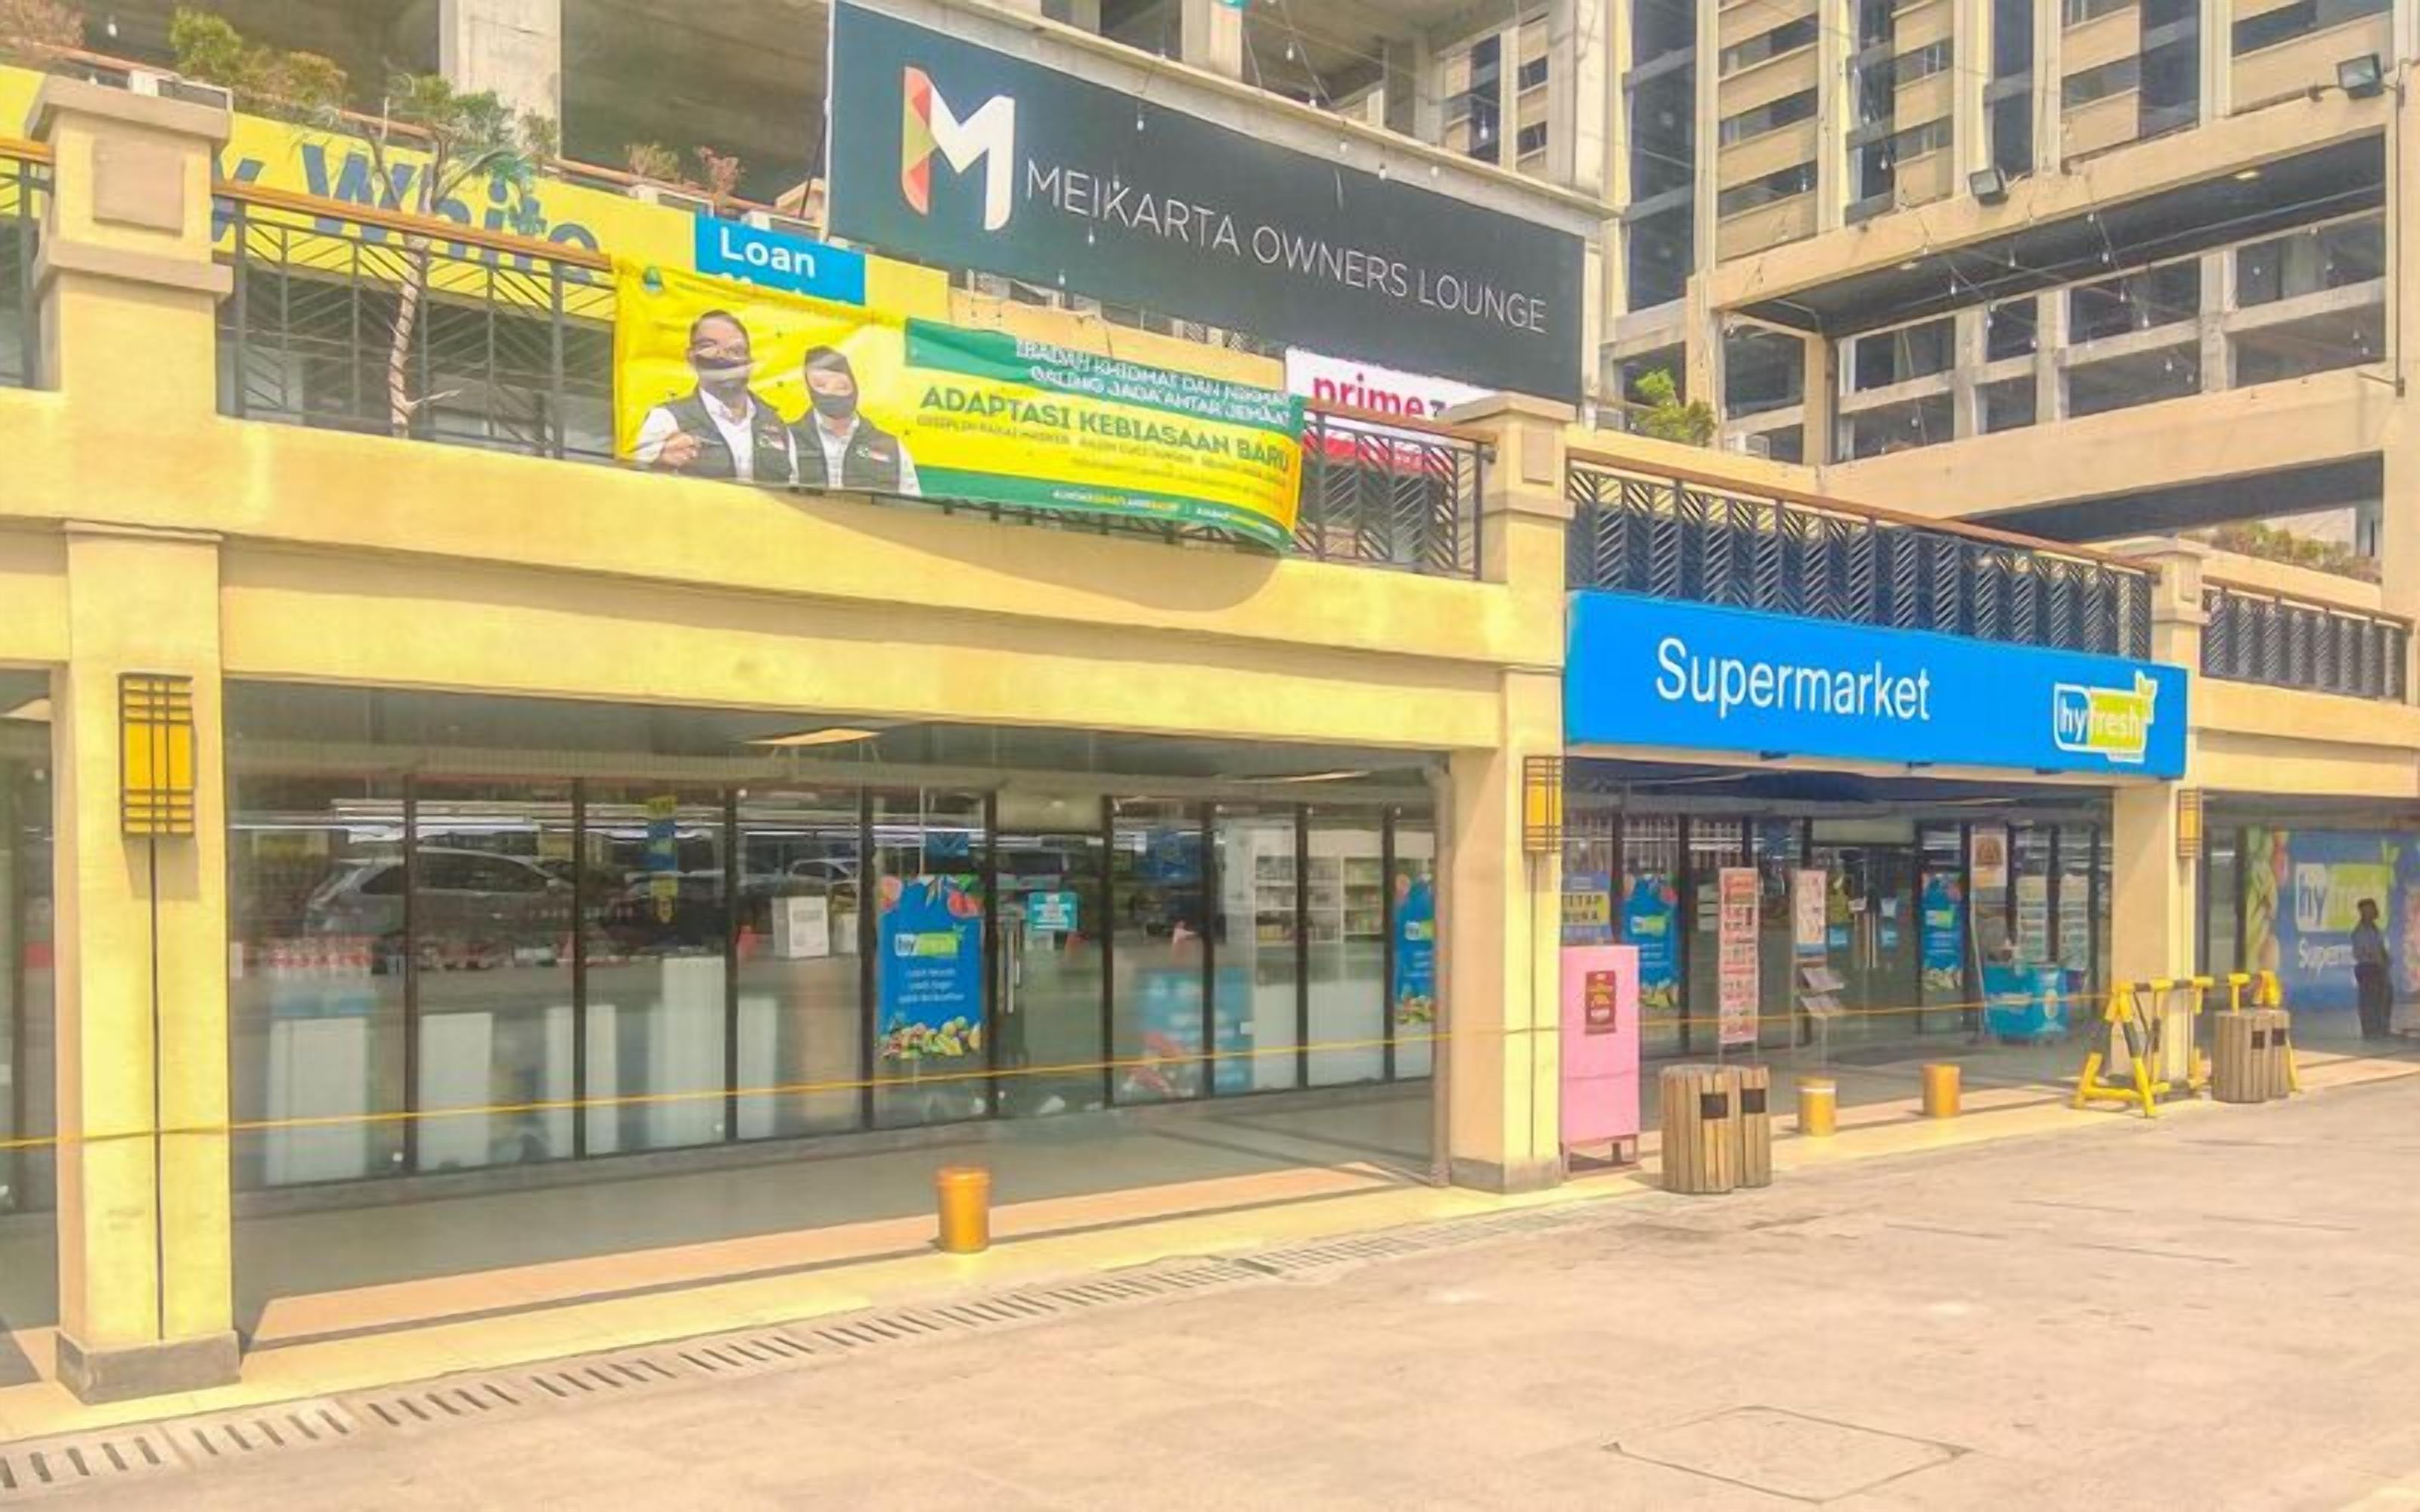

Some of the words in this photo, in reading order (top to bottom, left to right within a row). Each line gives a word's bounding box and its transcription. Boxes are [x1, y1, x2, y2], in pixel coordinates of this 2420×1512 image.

[721, 226, 816, 279] Loan
[1026, 158, 1241, 257] MEIKARTA
[1252, 225, 1408, 297] OWNERS
[1418, 268, 1549, 335] LOUNGE
[920, 386, 1071, 430] ADAPTASI
[1079, 411, 1230, 454] KEBIASAAN
[1655, 637, 1931, 721] Supermarket
